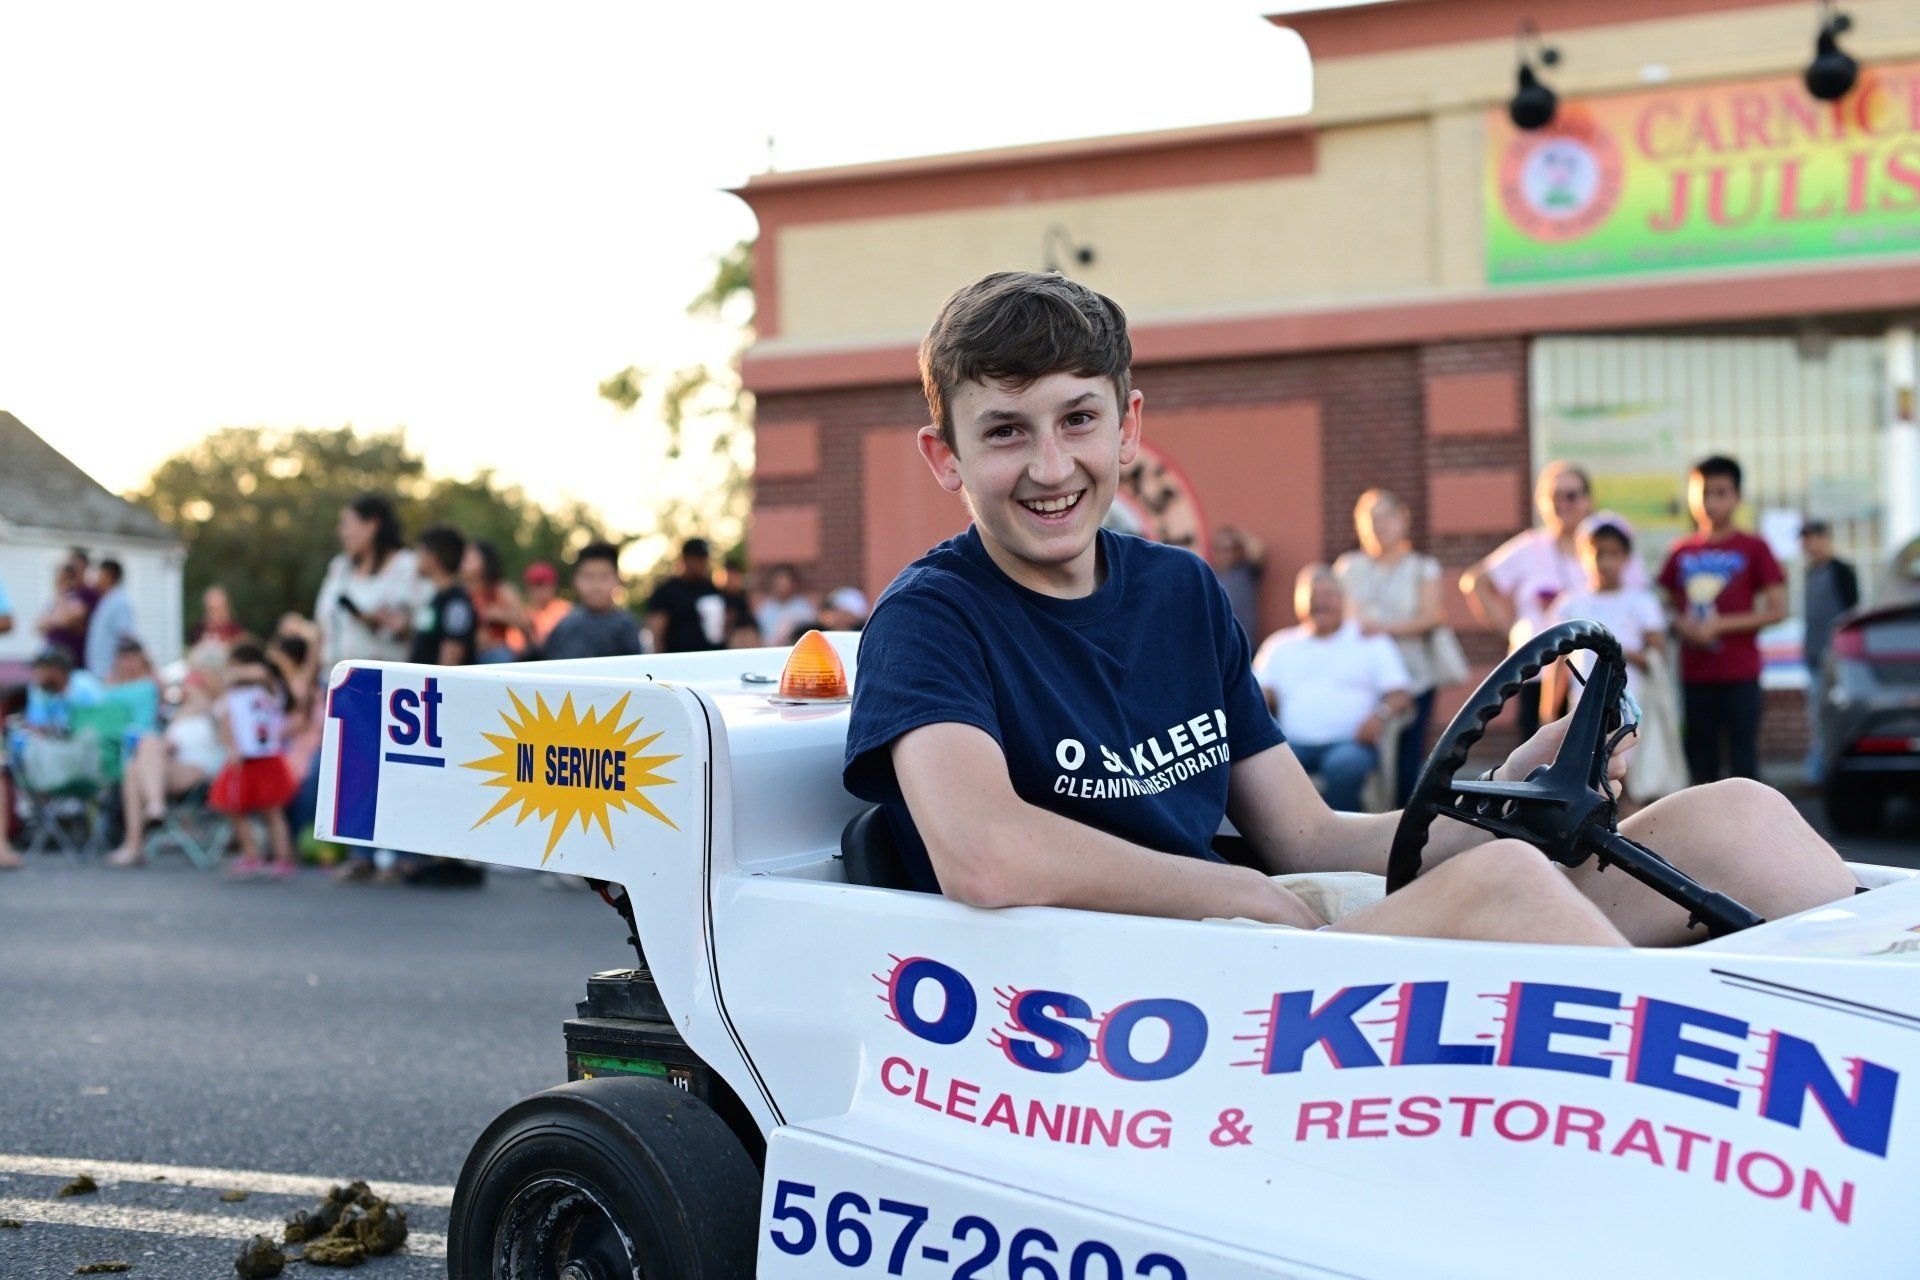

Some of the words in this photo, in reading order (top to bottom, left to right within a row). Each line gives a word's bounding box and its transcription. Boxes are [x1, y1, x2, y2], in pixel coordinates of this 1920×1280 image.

[1635, 75, 1920, 163] CARNIC
[328, 667, 443, 842] 1st
[516, 742, 534, 784] IN
[545, 744, 627, 792] SERVICE
[1055, 738, 1086, 771] O
[888, 956, 978, 1046] O
[1001, 988, 1209, 1082] SO
[1261, 980, 1900, 1159] KLEEN
[880, 1056, 1173, 1150] CLEANING
[1209, 1107, 1254, 1148] &
[1294, 1096, 1856, 1226] RESTORATION
